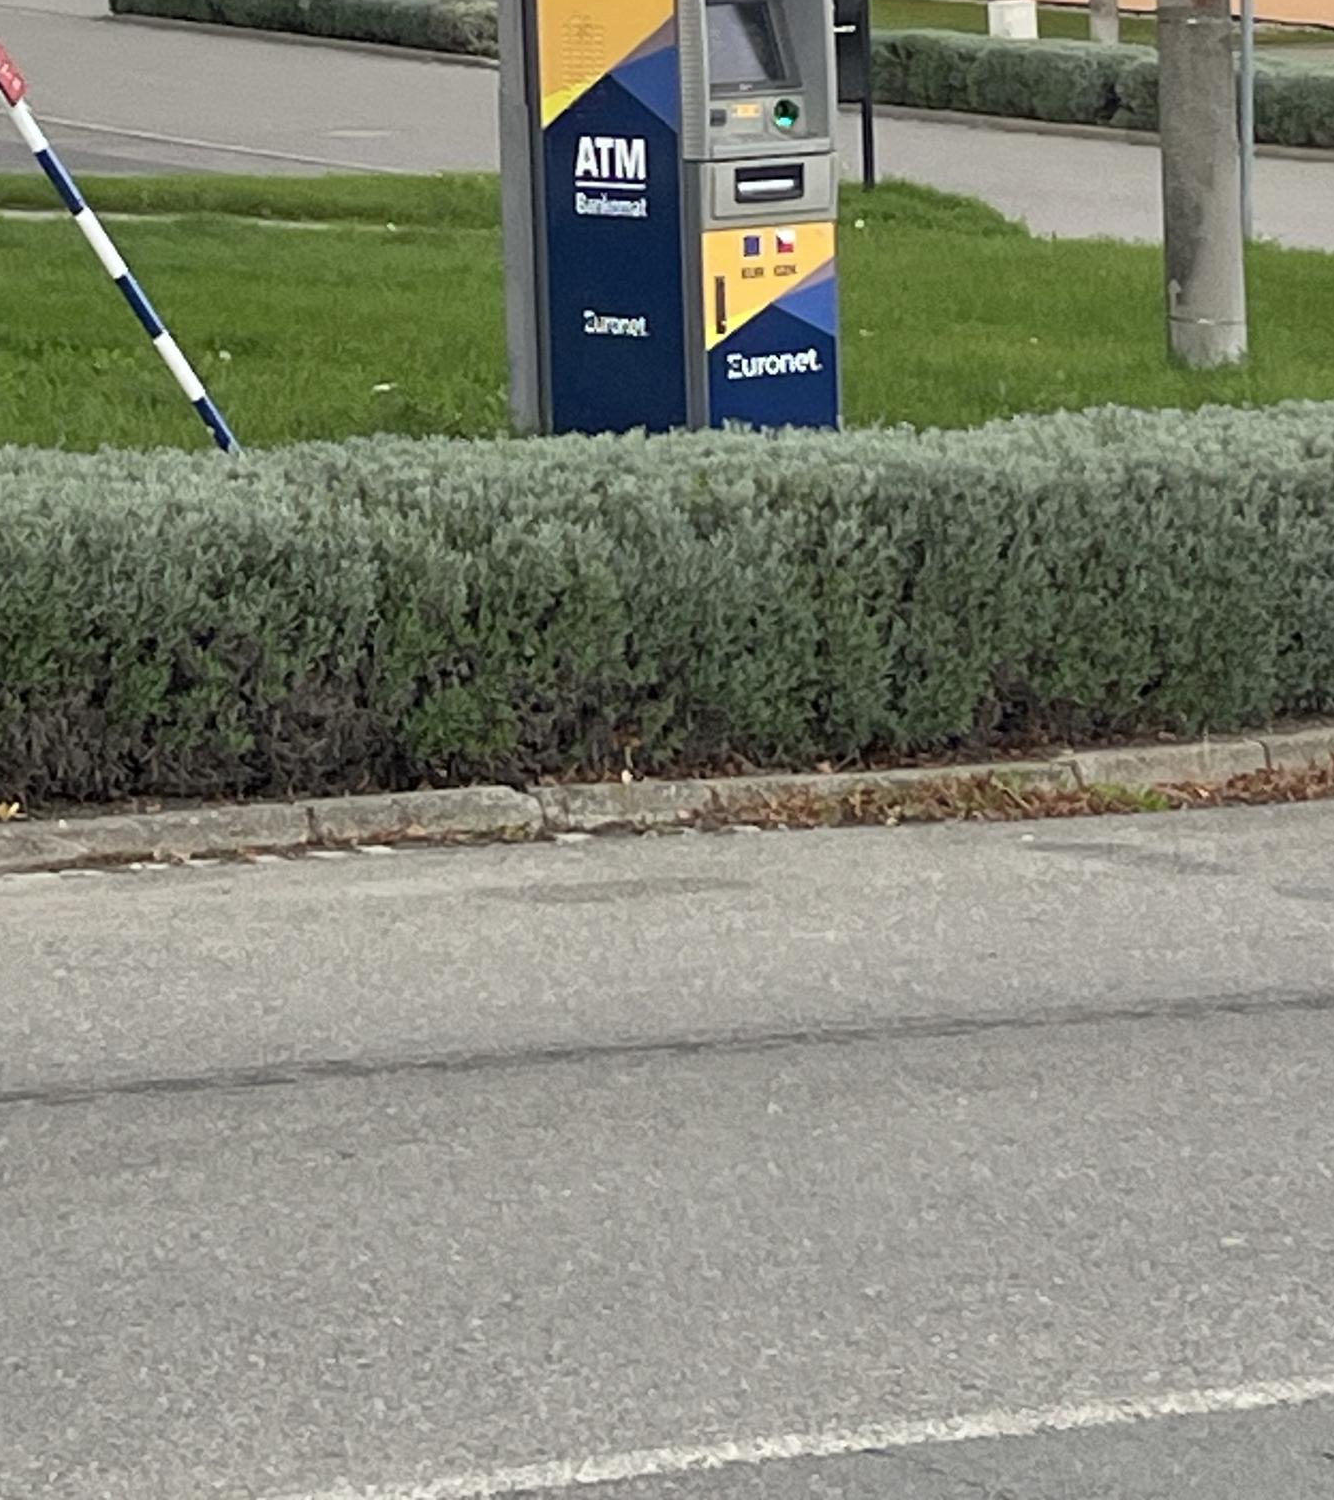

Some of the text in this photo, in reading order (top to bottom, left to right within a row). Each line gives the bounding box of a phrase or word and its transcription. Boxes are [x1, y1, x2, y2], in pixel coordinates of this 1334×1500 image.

[574, 136, 647, 181] ATM
[583, 309, 649, 338] Euronet
[726, 347, 824, 380] Euronet
